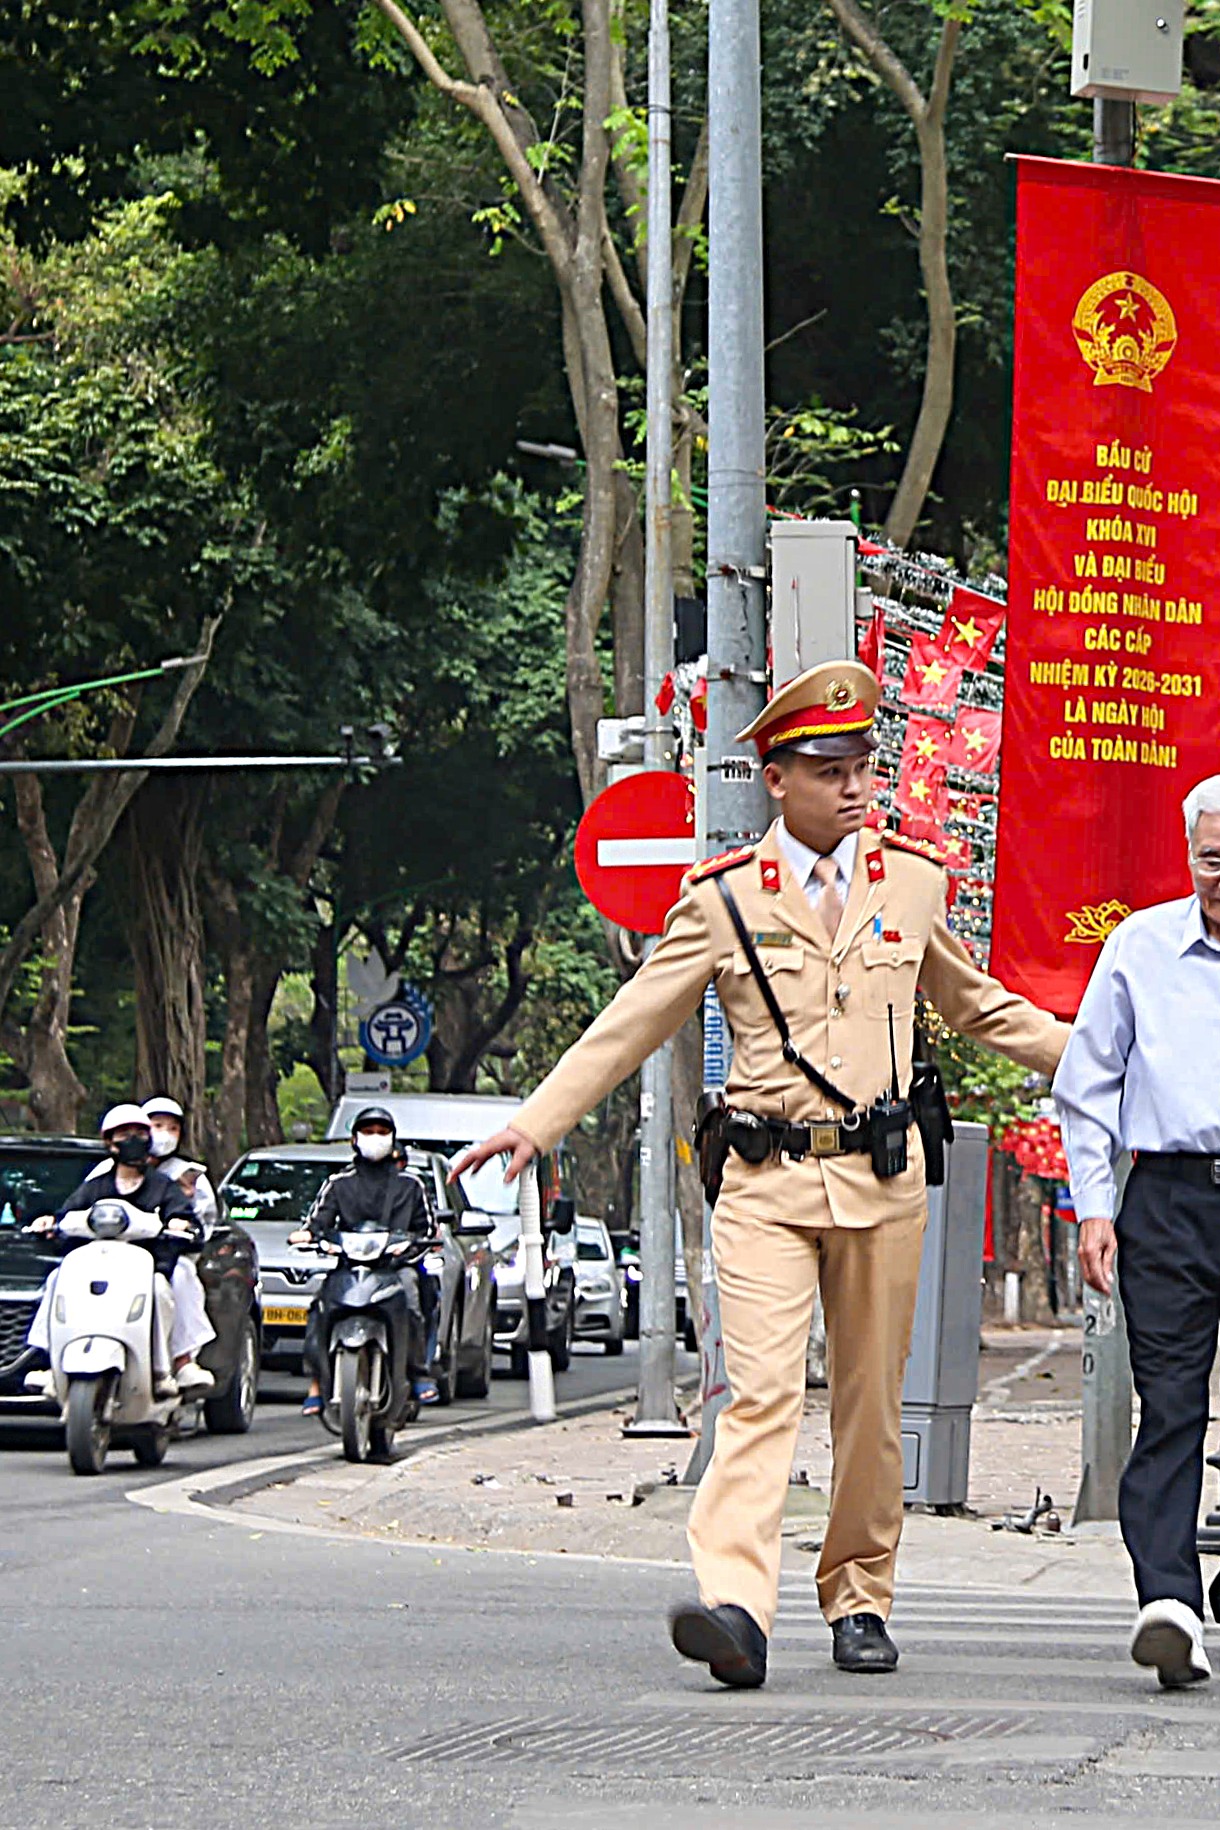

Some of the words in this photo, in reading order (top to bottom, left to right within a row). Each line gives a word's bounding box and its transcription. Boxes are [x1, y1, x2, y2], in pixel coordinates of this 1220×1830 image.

[1047, 479, 1078, 508] ĐẠI
[1079, 473, 1124, 505] BIỂU
[1127, 481, 1163, 513] QUỐC
[1167, 488, 1198, 521] HỘI
[1086, 514, 1133, 543] KHÓA
[1135, 522, 1157, 548] XVI
[1074, 550, 1098, 578] VÀ
[1102, 555, 1131, 583] ĐẠI
[1134, 553, 1165, 585] BIỂU
[1033, 584, 1064, 617] HỘI
[1123, 592, 1160, 622] NHÂN
[1165, 597, 1202, 625] DÂN
[1084, 623, 1121, 651] CÁC
[1125, 625, 1152, 656] CẤP
[1030, 657, 1089, 691] NHIỆM
[1094, 660, 1118, 688] KỲ
[1121, 666, 1202, 697] 2026-2031
[1064, 695, 1087, 723] LÀ
[1092, 697, 1139, 726] NGÀY
[1141, 702, 1165, 735] HỘI
[1050, 729, 1086, 760] CỦA
[1091, 734, 1138, 763] TOÀN
[1141, 738, 1177, 768] DÂN!
